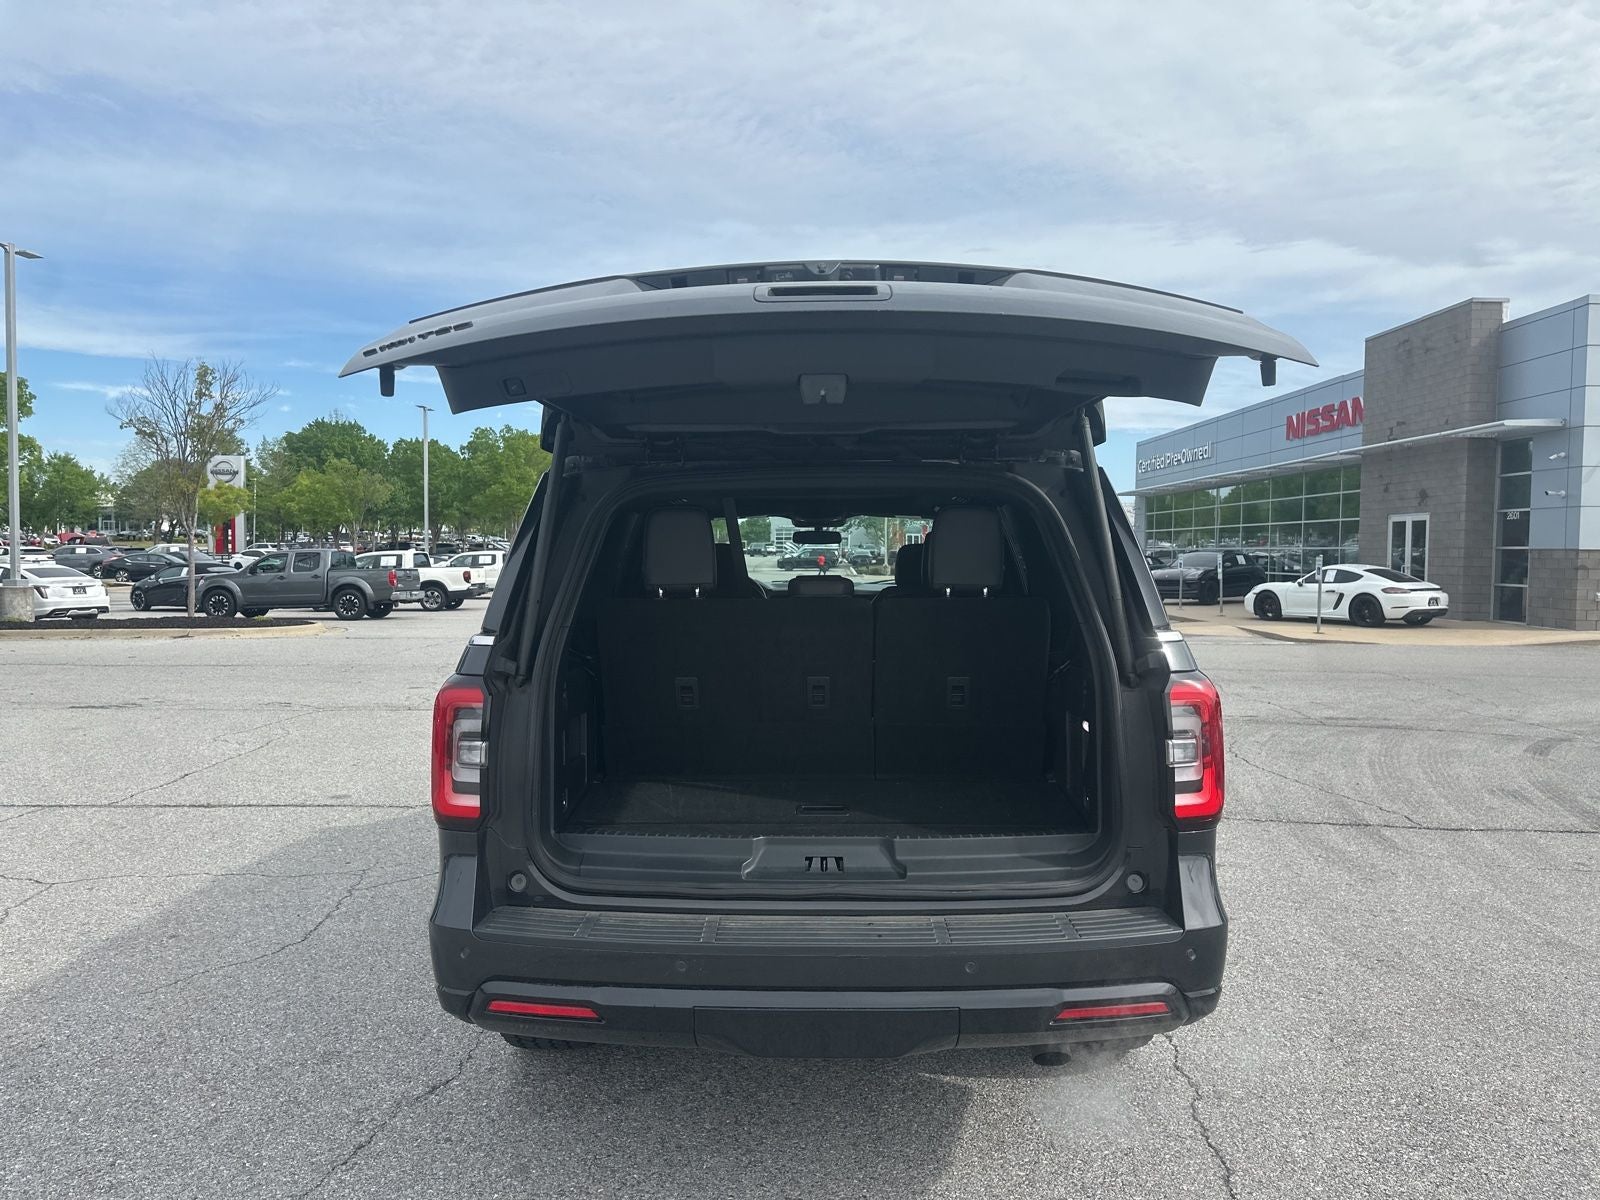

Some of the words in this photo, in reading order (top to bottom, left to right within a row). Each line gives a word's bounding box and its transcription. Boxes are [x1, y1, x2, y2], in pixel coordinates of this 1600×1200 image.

[1286, 396, 1363, 441] NISSAN
[1138, 454, 1165, 473] Certified
[1166, 441, 1211, 467] Pre-Owned
